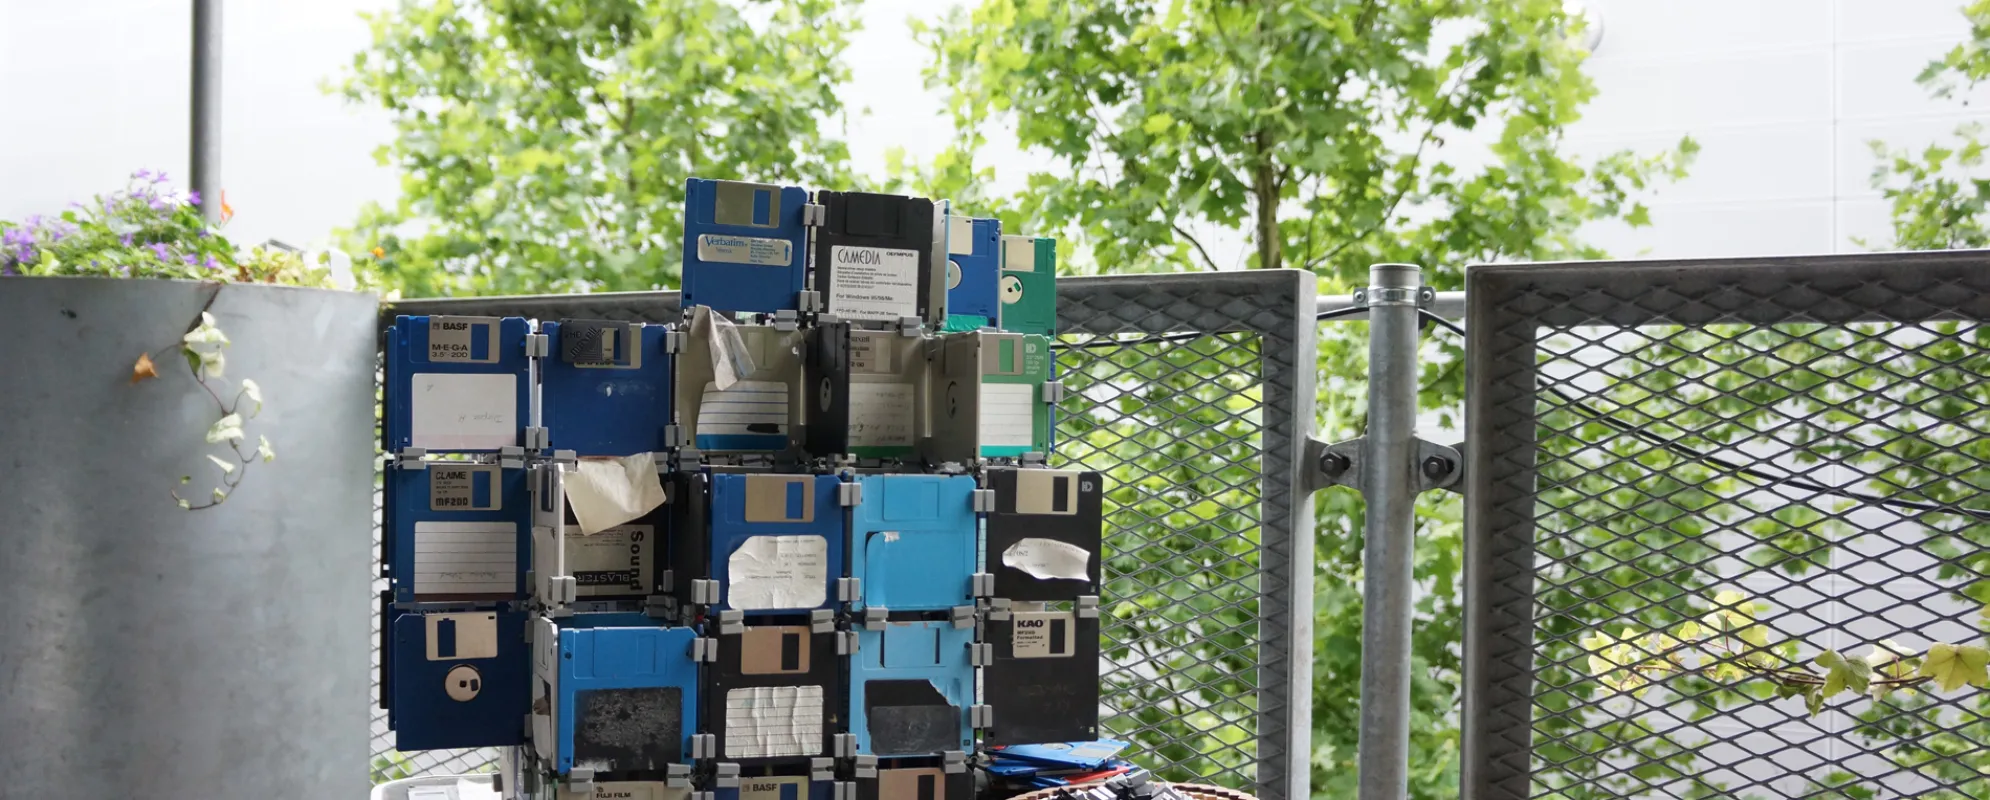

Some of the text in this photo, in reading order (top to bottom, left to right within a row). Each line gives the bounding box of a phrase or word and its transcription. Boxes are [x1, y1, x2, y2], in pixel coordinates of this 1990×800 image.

[705, 236, 745, 247] Verbatim
[838, 249, 881, 265] CAMEDIA
[443, 322, 468, 330] BASF
[630, 531, 644, 590] Sound
[577, 572, 630, 582] BLASTER
[1017, 620, 1043, 628] KAO
[753, 784, 777, 792] BASF
